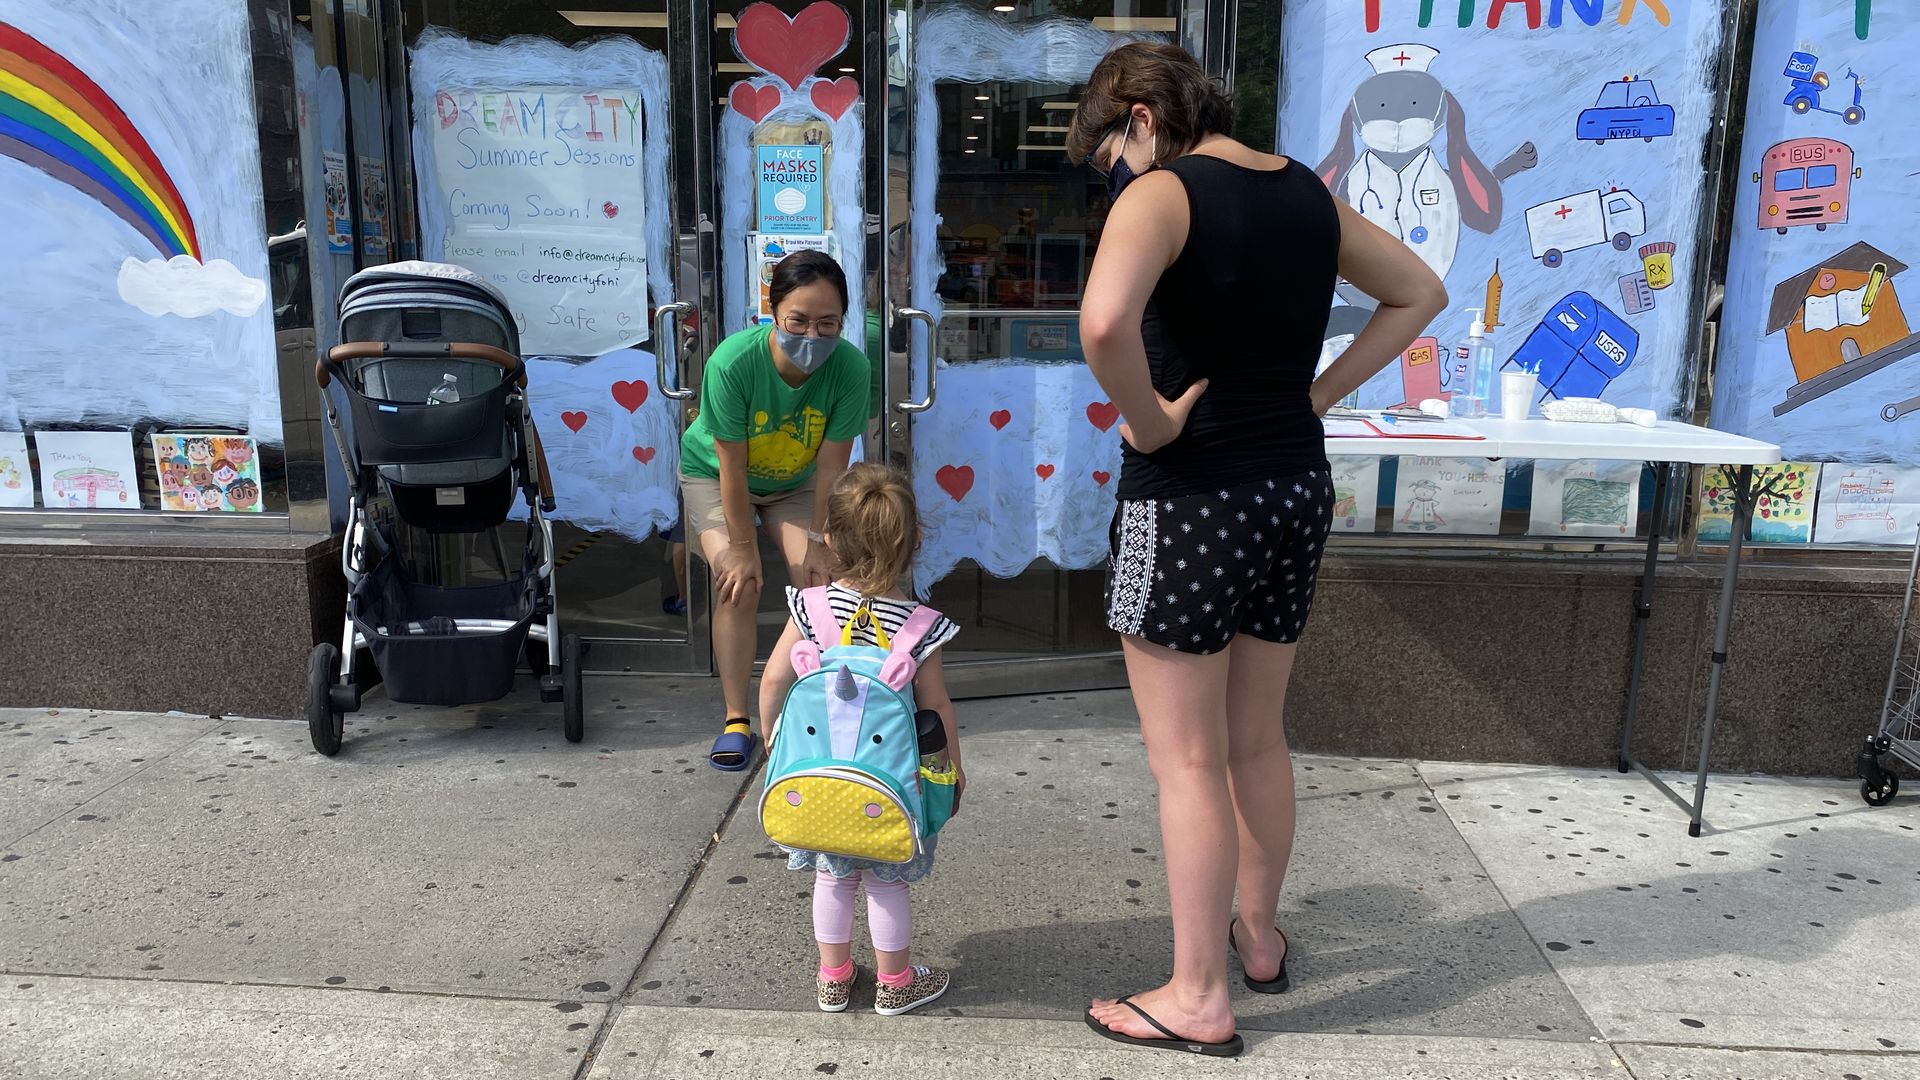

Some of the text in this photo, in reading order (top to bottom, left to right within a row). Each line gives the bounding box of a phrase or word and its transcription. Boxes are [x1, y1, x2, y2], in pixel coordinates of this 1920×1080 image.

[435, 91, 641, 147] DREAM CITY
[1610, 128, 1640, 139] NYPD
[456, 126, 636, 170] Summer Sessions
[777, 149, 803, 159] FACE
[1793, 147, 1823, 161] BUS
[763, 160, 817, 173] MASKS
[763, 173, 817, 184] REQUIRED
[450, 188, 591, 231] Coming Soon!
[442, 239, 484, 257] Please
[494, 243, 525, 257] email
[546, 305, 598, 332] Safe
[1410, 350, 1430, 362] GAS
[1597, 334, 1625, 362] USPS
